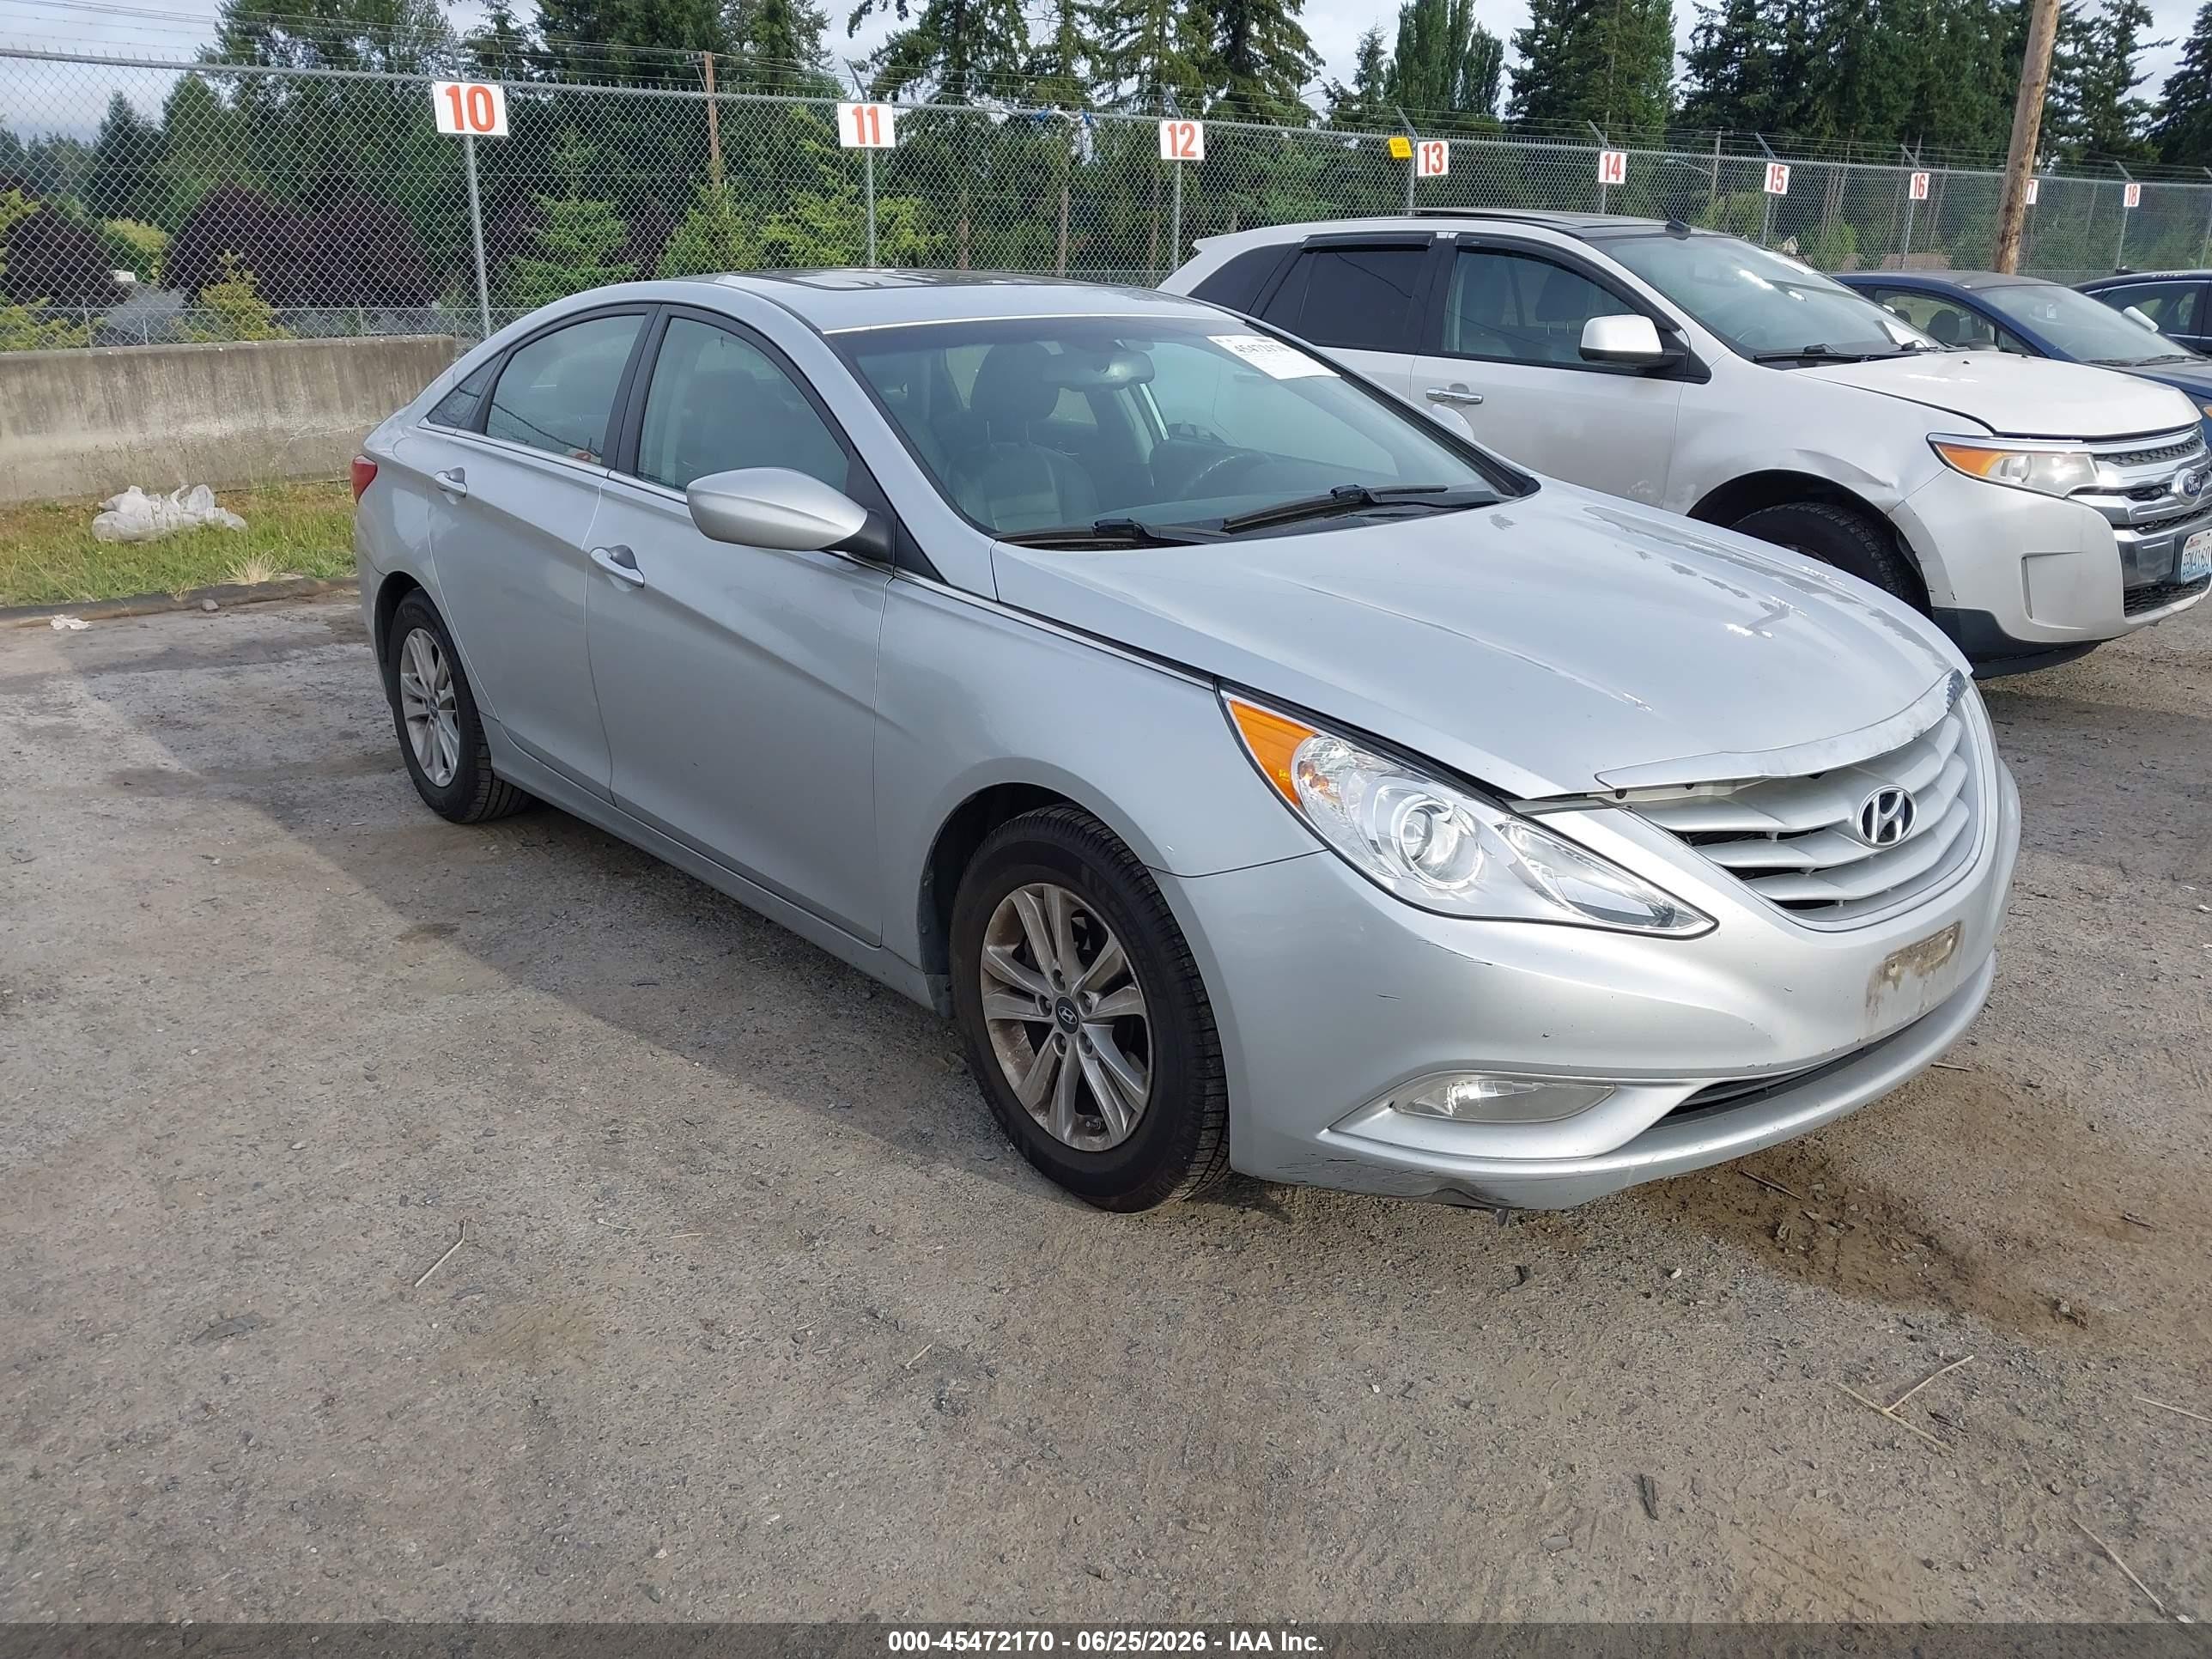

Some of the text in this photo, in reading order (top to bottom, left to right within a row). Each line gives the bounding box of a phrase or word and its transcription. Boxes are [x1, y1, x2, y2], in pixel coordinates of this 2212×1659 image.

[444, 84, 495, 133] 10
[853, 106, 880, 144] 11
[1169, 123, 1195, 158] 12
[1423, 142, 1444, 174] 13
[1605, 153, 1621, 180] 14
[1770, 165, 1785, 191] 15
[1914, 174, 1925, 198] 16
[2128, 185, 2137, 205] 18
[2188, 476, 2201, 492] Ford
